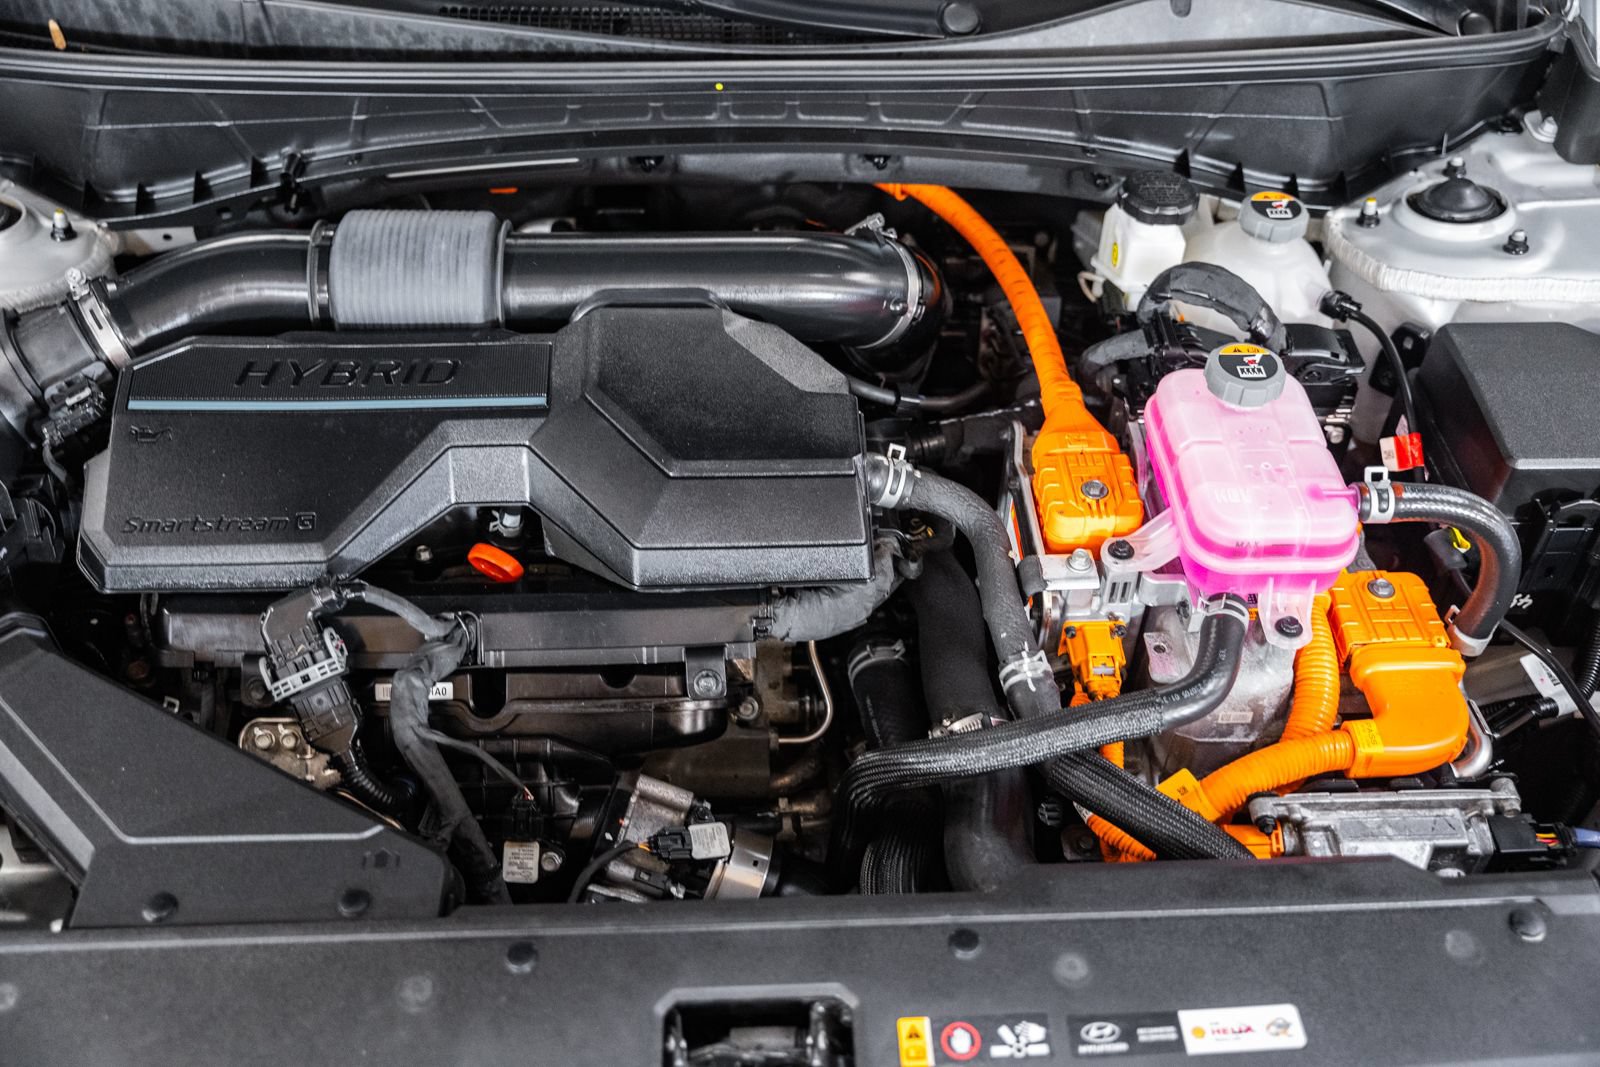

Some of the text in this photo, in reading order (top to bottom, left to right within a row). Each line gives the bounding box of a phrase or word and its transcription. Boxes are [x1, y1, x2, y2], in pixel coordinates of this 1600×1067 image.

[234, 358, 459, 388] HYBRID
[122, 512, 316, 534] Smartstream G
